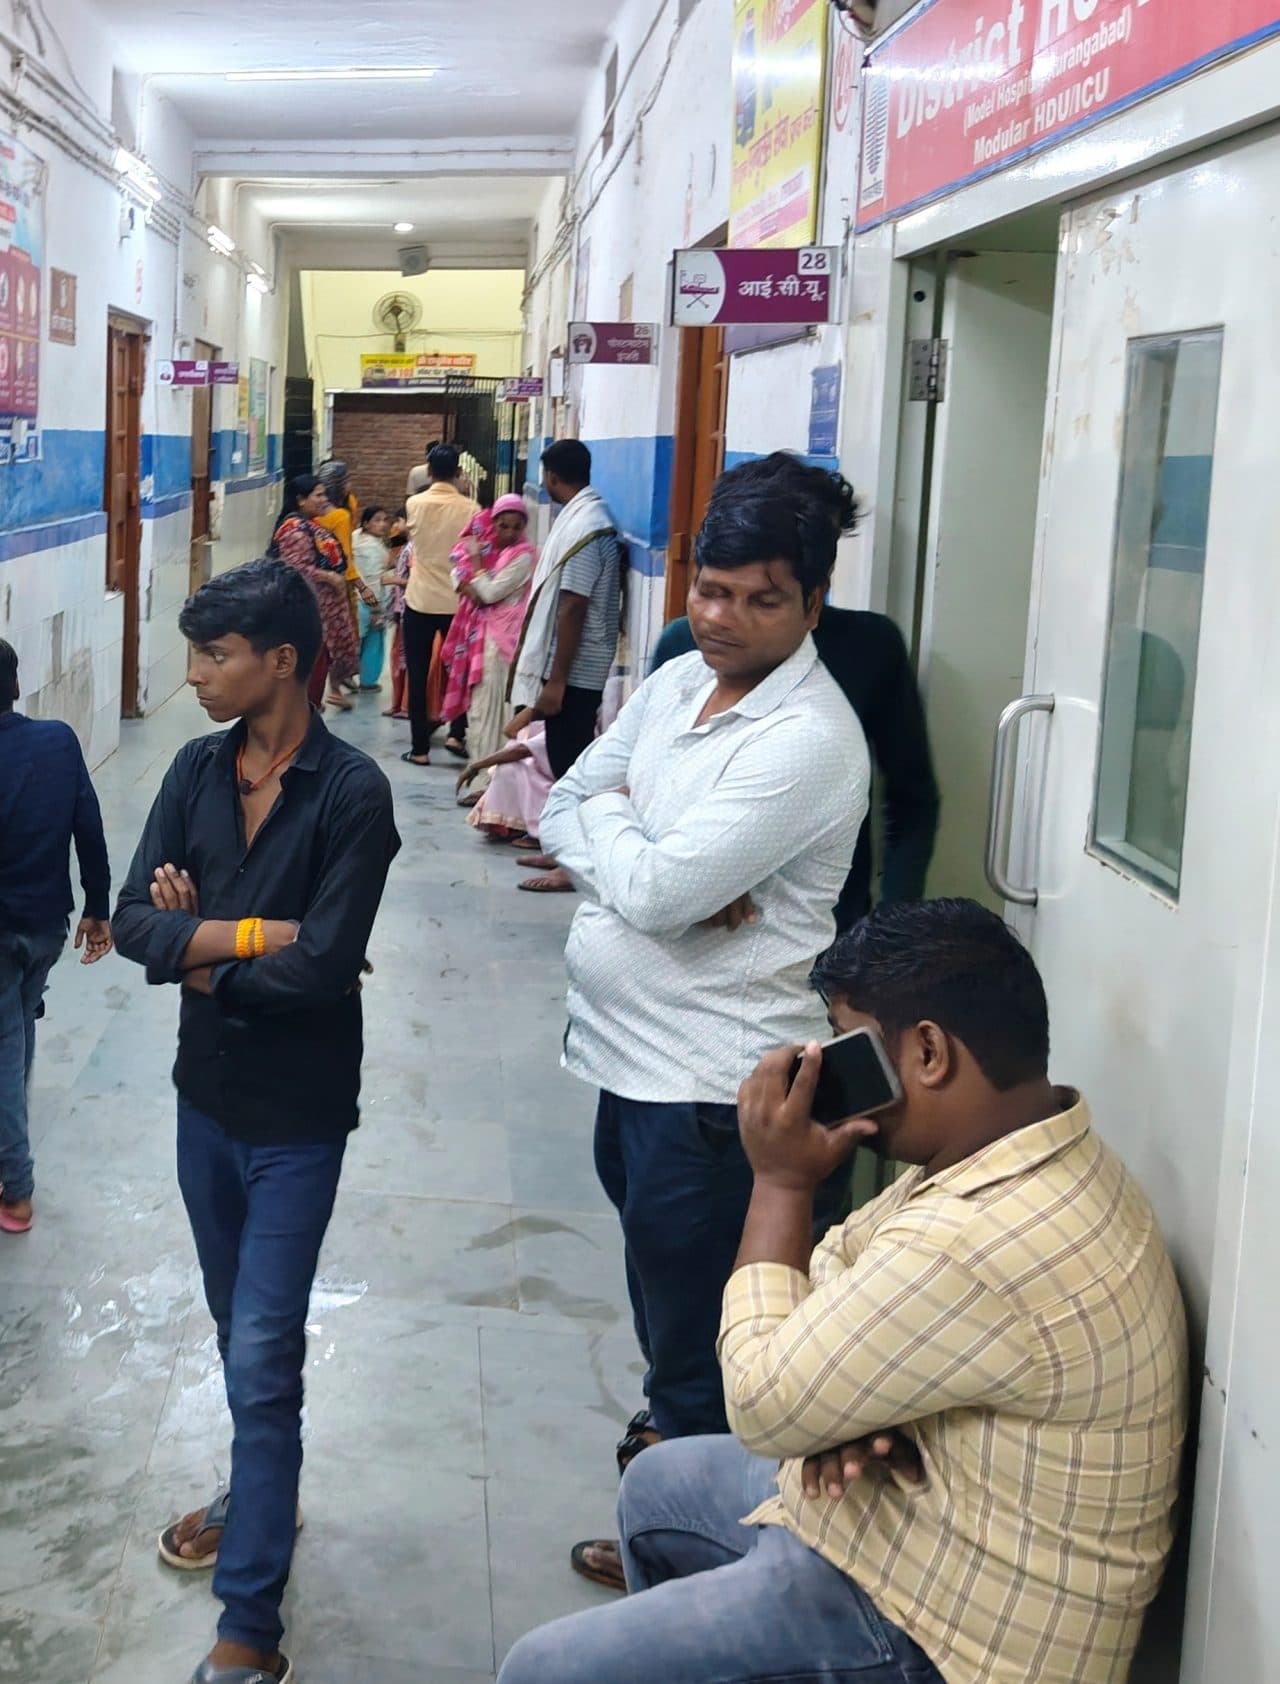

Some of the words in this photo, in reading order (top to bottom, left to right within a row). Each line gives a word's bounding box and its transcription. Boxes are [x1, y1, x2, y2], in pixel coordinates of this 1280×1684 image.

[1048, 4, 1132, 80] urangabad)
[973, 117, 1032, 166] Modular
[1033, 66, 1111, 135] HDU/ICU
[801, 252, 827, 270] 28
